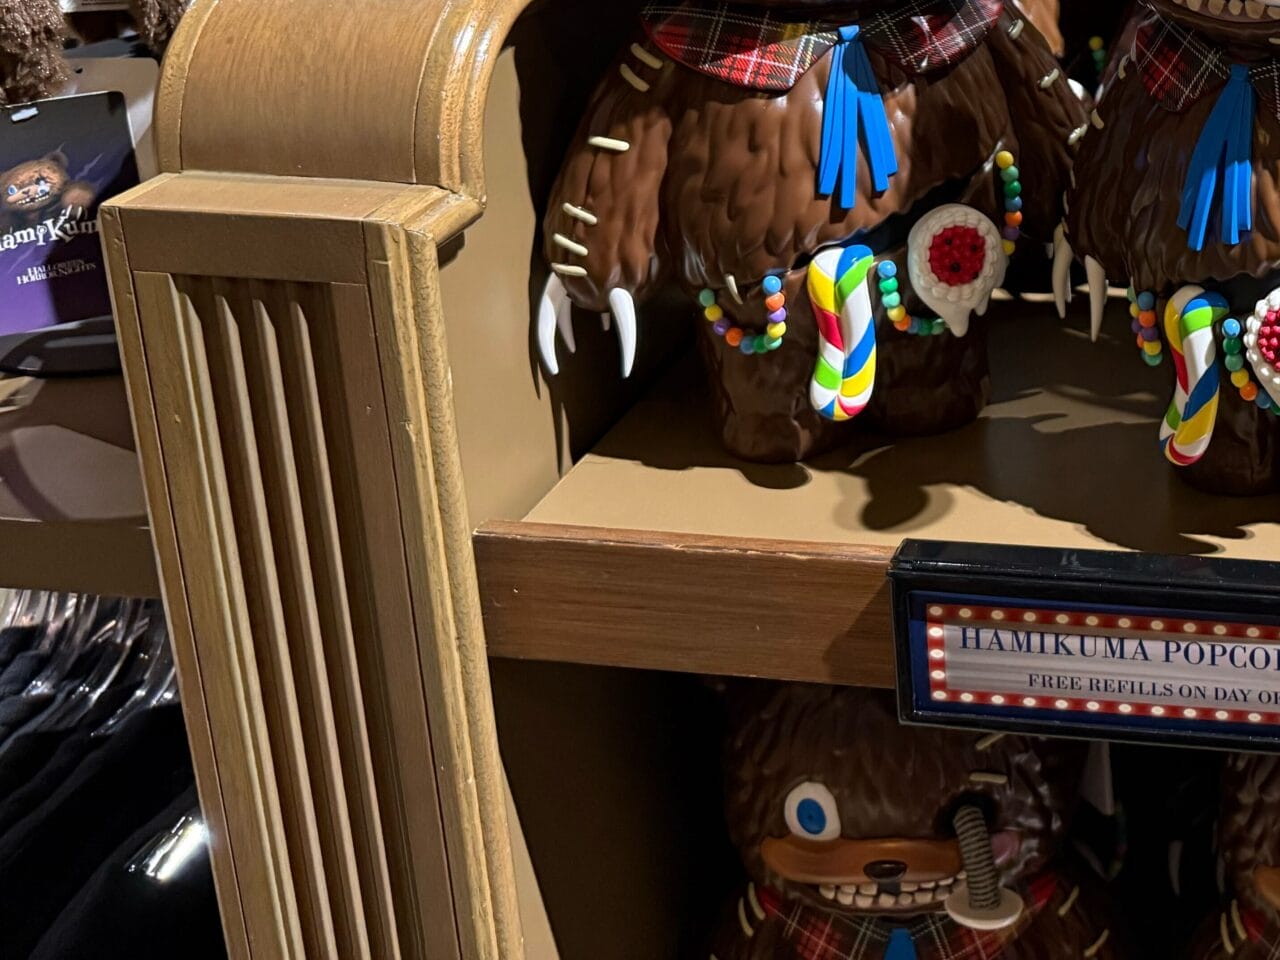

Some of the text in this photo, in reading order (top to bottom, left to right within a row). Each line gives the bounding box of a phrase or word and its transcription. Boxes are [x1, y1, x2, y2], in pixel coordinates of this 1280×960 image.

[959, 626, 1153, 662] HAMIKUMA
[1028, 673, 1083, 691] FREE
[1088, 677, 1173, 698] REFILLS
[1178, 684, 1207, 701] ON
[1214, 686, 1252, 703] DAY
